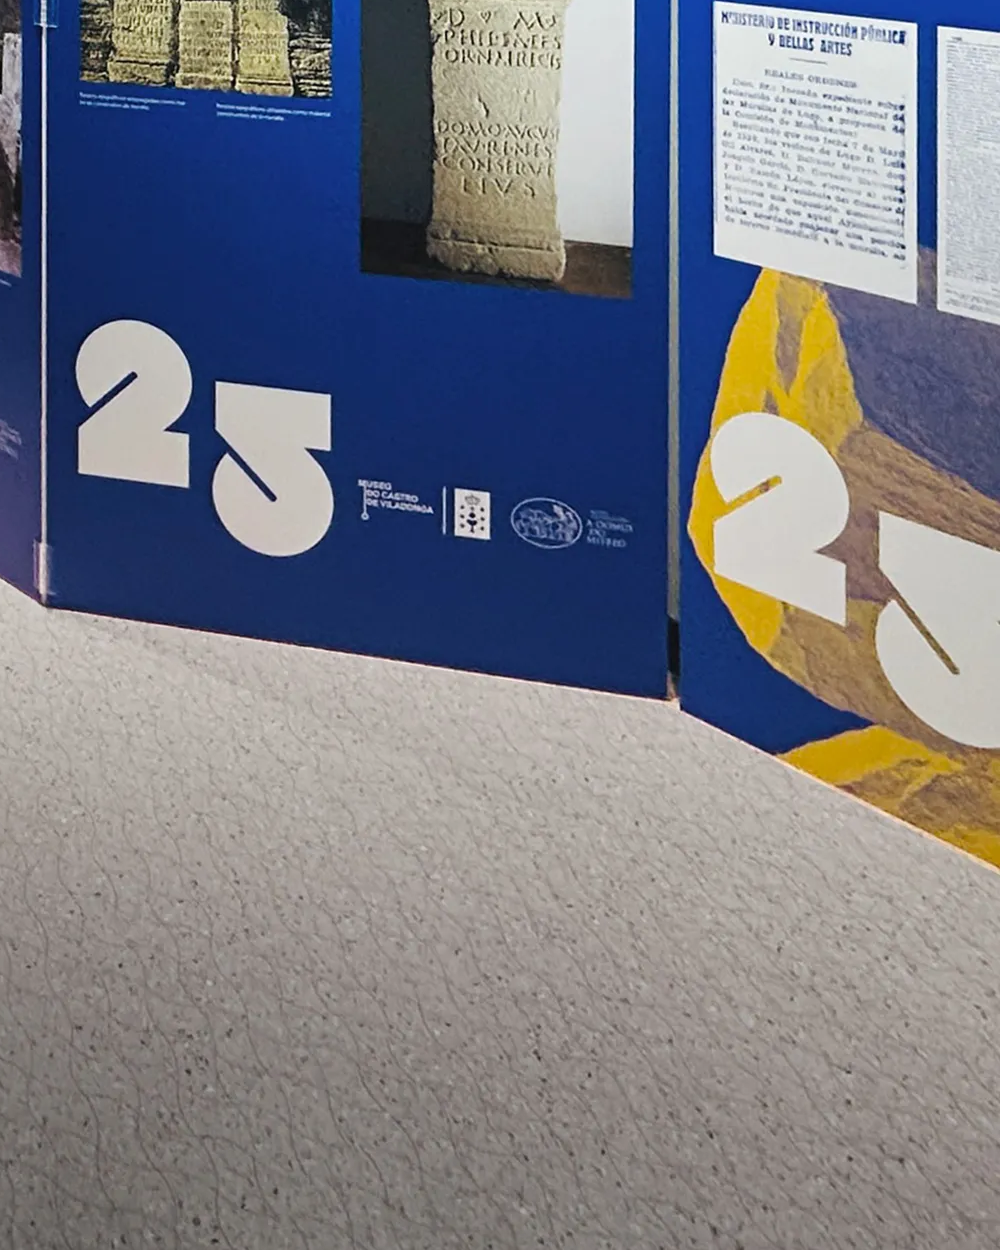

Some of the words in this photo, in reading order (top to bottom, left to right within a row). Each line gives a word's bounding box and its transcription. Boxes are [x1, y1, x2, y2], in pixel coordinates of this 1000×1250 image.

[777, 18, 790, 30] DE
[820, 41, 853, 57] ARTES
[75, 319, 334, 557] 25
